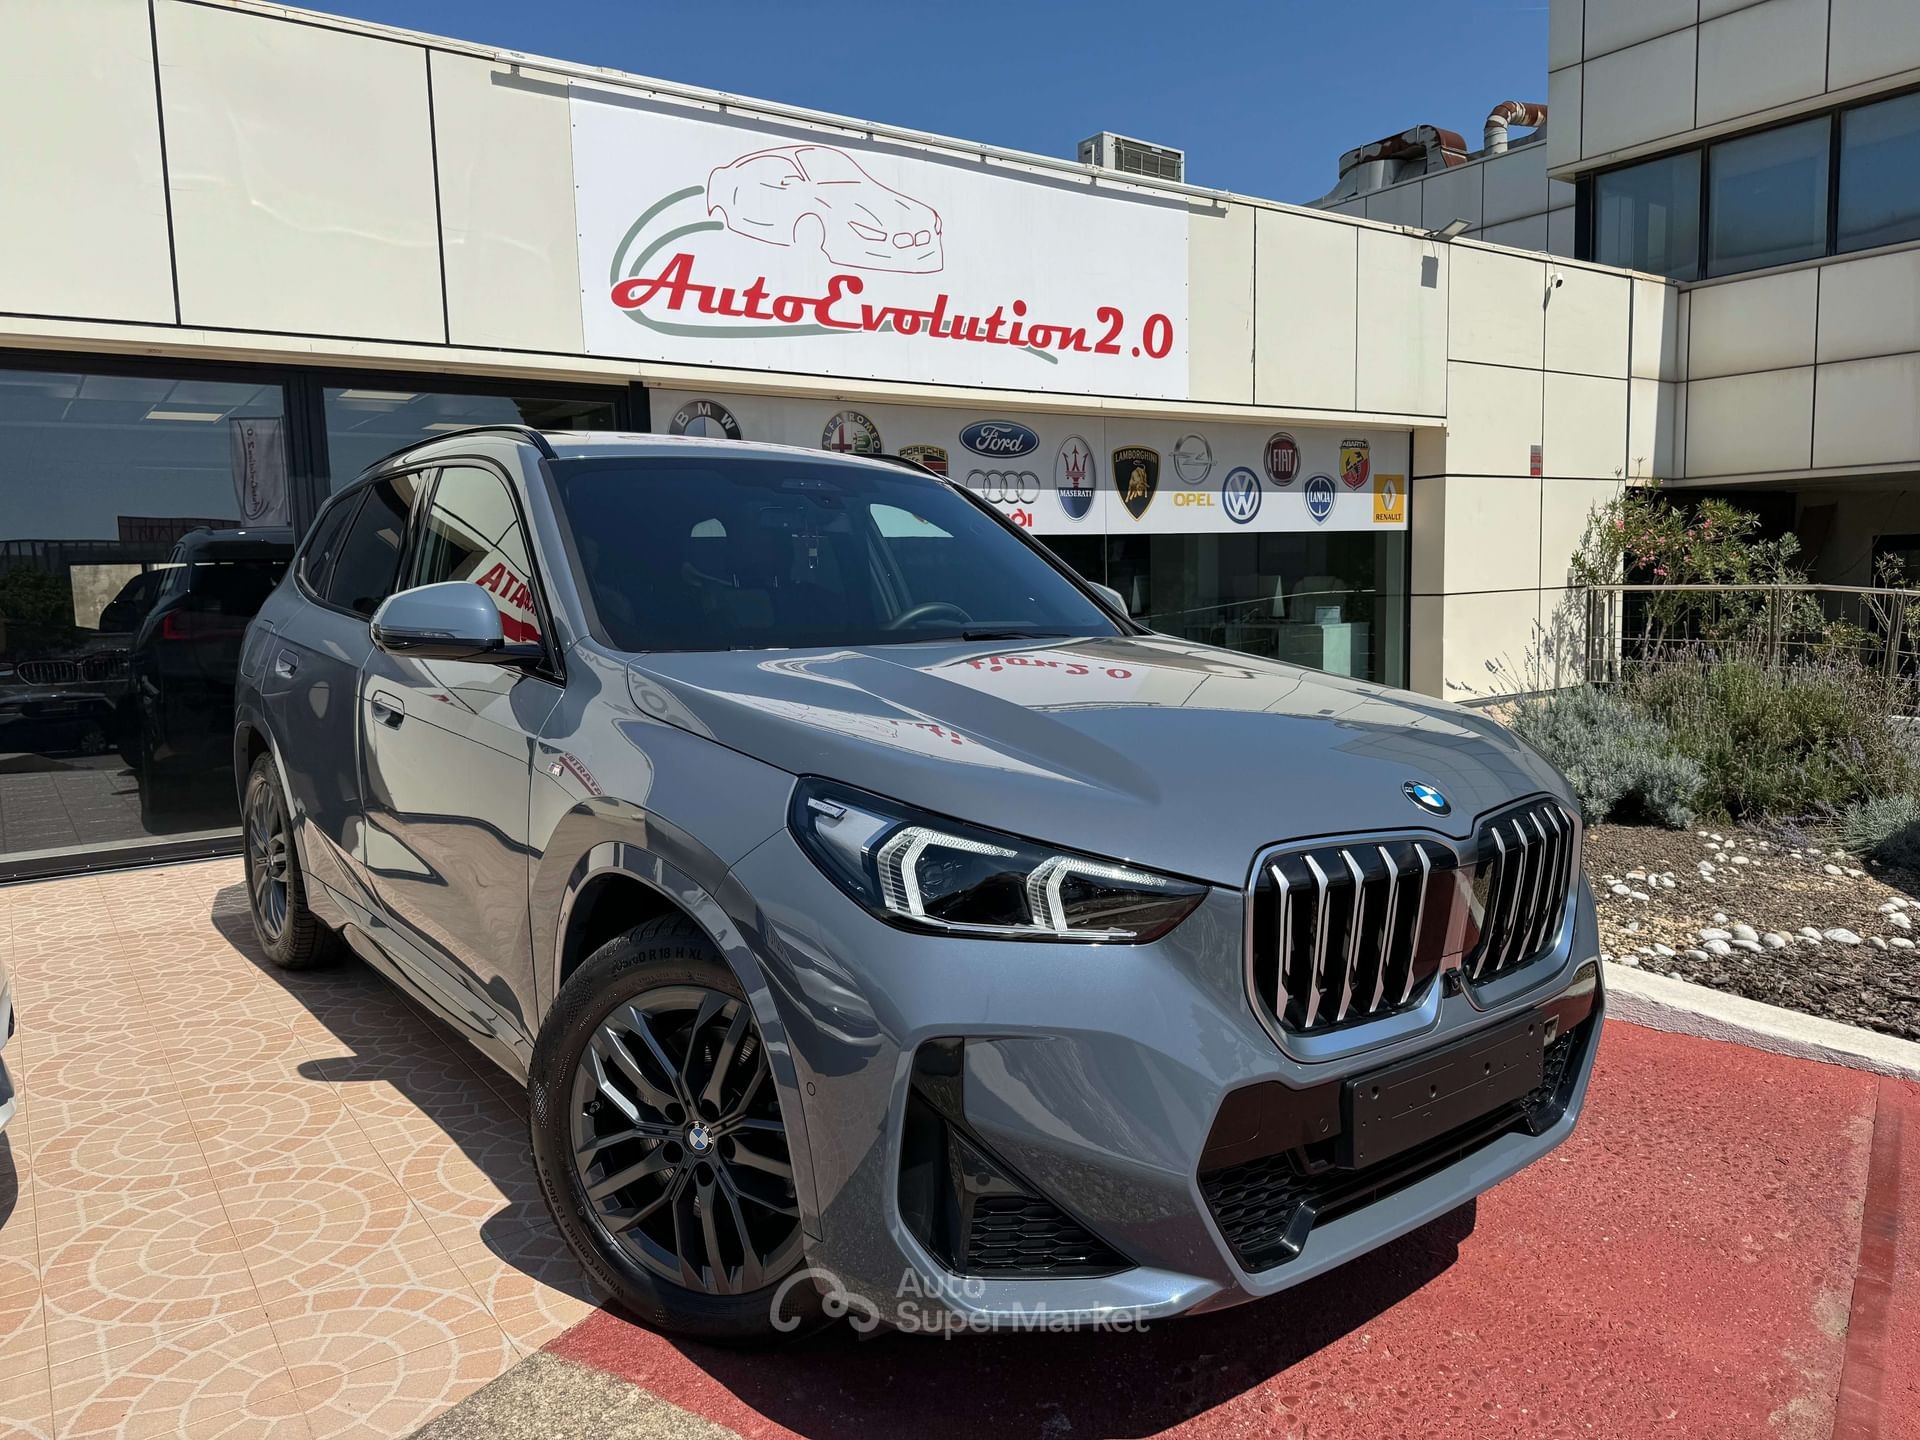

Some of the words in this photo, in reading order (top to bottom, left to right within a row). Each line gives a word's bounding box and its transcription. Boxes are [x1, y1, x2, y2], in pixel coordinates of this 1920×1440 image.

[675, 402, 736, 430] BMW
[823, 416, 843, 449] ALFA
[848, 413, 881, 449] ROMEO
[975, 425, 1024, 454] Ford
[1342, 440, 1368, 449] ABARTH
[900, 446, 946, 458] PORSCHE
[1114, 451, 1158, 465] LAMBORGHINI
[1272, 448, 1294, 474] FIAT
[1058, 489, 1092, 499] MASERATI
[1173, 492, 1215, 507] OPEL
[1308, 490, 1332, 504] LANCIA
[1008, 508, 1033, 528] di
[1375, 513, 1401, 521] RENAULT
[694, 1121, 715, 1144] BMW
